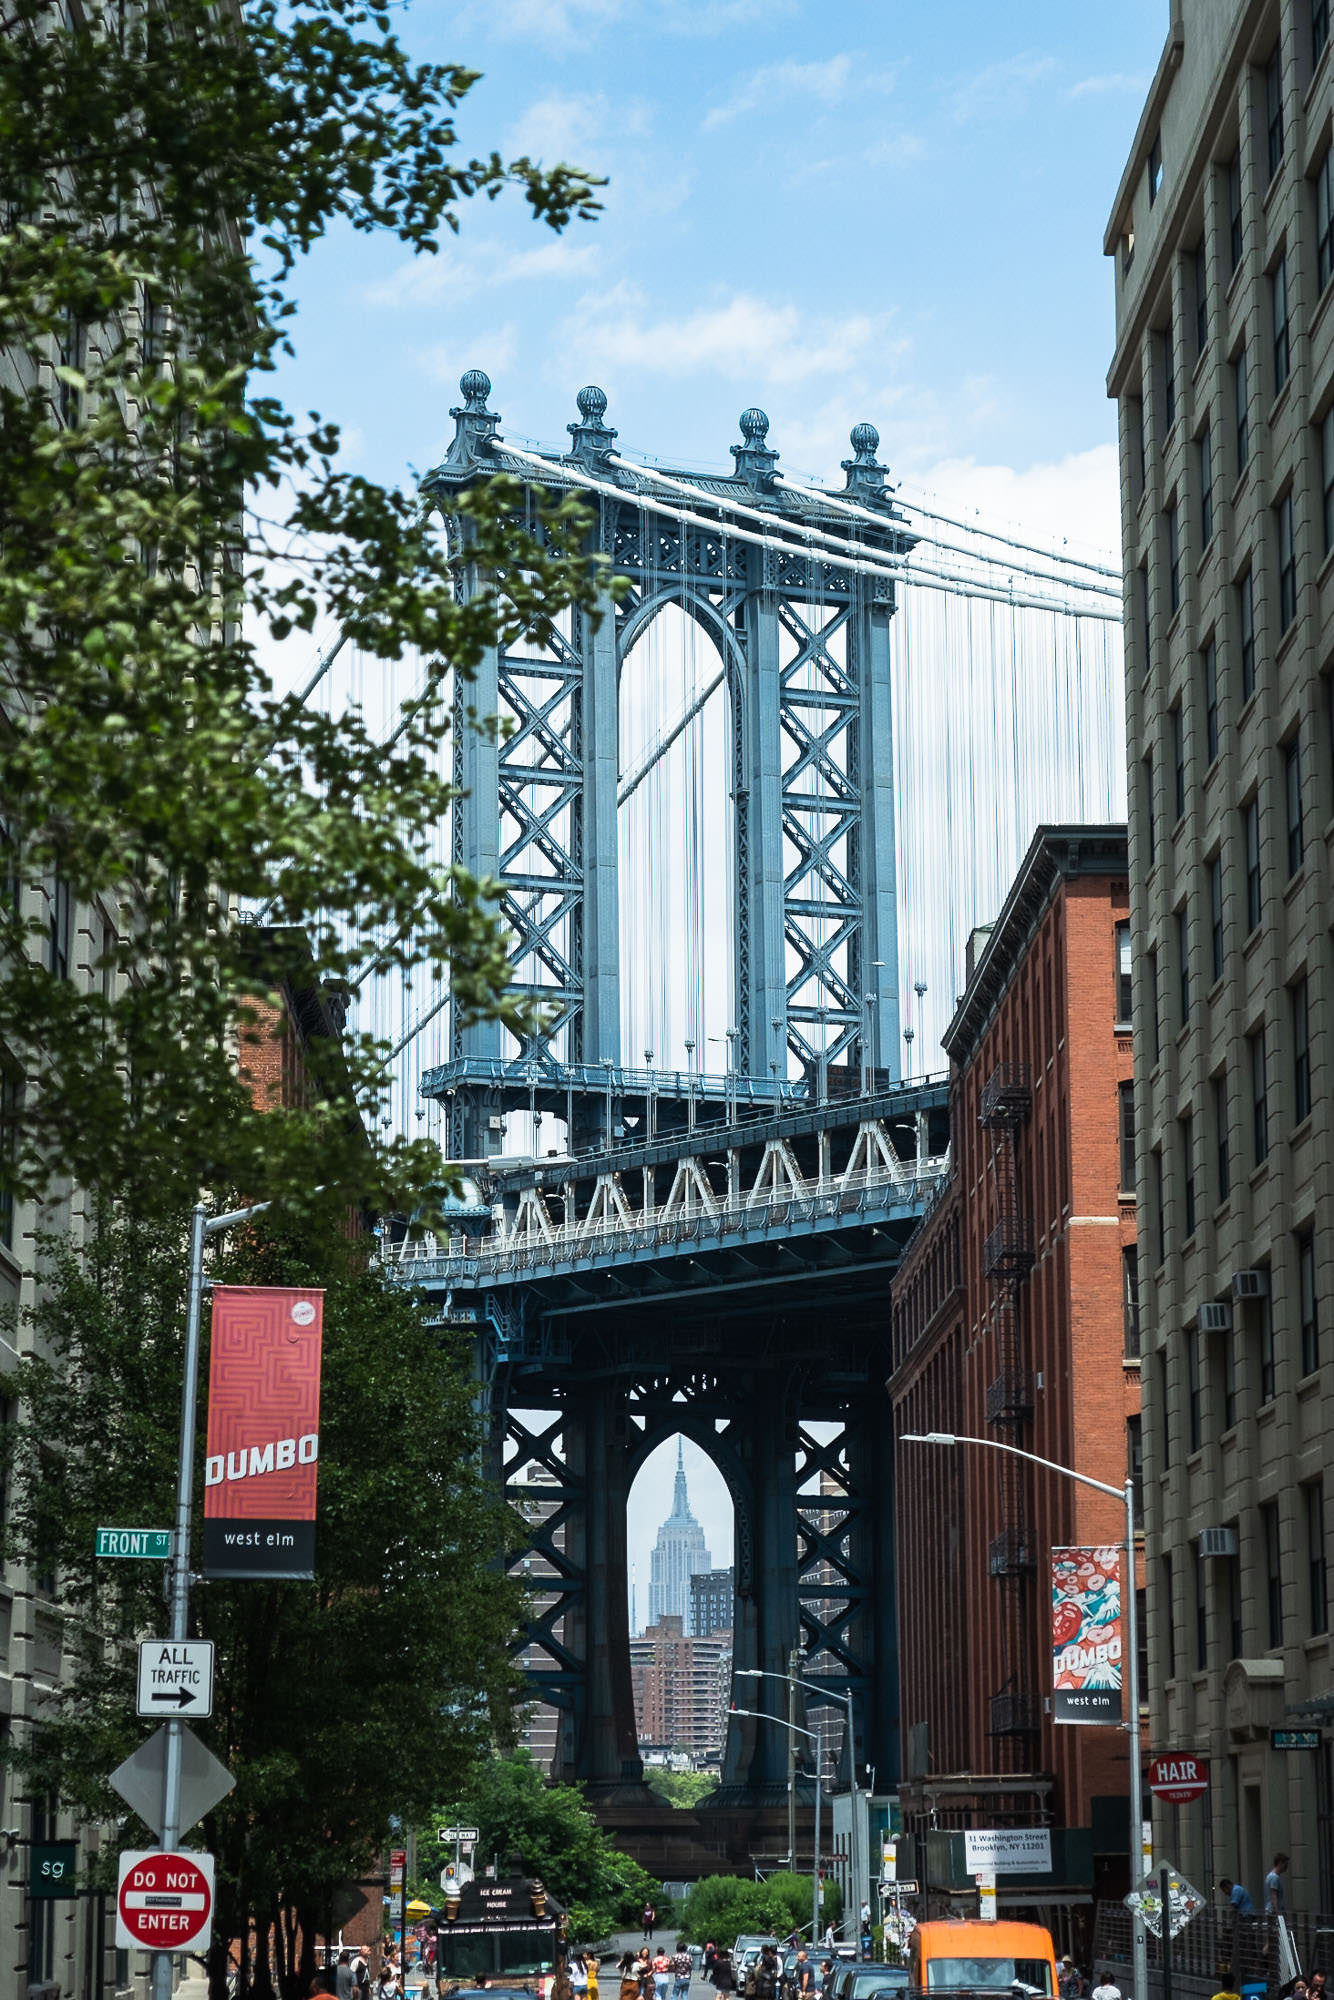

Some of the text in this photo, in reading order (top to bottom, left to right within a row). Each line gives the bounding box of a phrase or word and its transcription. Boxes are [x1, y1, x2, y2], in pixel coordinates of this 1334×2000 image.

[205, 1434, 319, 1487] DUMBO
[100, 1532, 167, 1554] FRONT ST
[225, 1531, 294, 1546] west elm
[158, 1647, 194, 1665] ALL
[1054, 1636, 1122, 1675] DUMBO
[151, 1669, 201, 1685] TRAFFIC
[1066, 1696, 1110, 1706] west elm
[1156, 1760, 1198, 1782] HAIR
[979, 1833, 1023, 1843] Washington
[1024, 1833, 1048, 1841] Street
[972, 1842, 1045, 1853] Brooklyn, NY 11201
[41, 1861, 65, 1878] sg
[133, 1871, 198, 1889] DO NOT
[480, 1887, 513, 1897] ICE CREAM
[137, 1913, 190, 1931] ENTER
